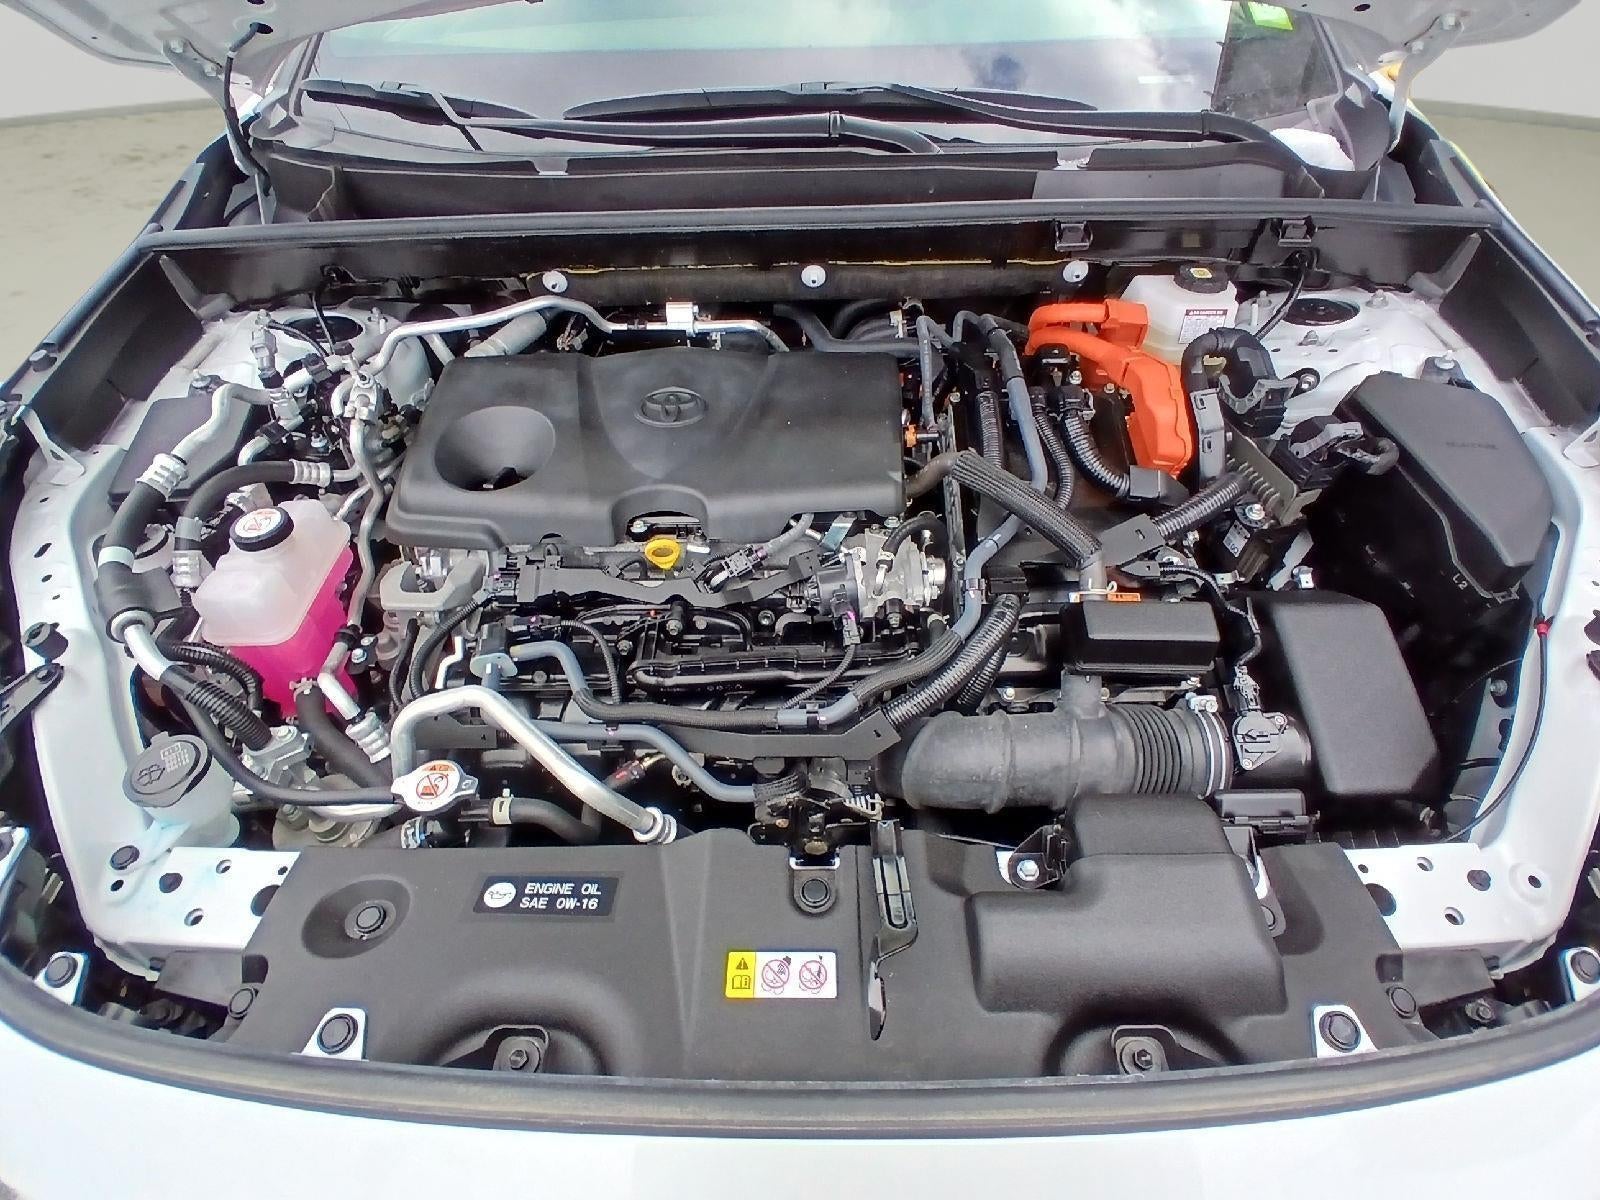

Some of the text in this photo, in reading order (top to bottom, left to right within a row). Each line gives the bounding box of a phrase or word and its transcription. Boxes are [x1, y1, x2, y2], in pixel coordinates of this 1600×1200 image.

[524, 882, 602, 895] ENGINE OIL
[519, 897, 599, 910] SAE 0W-16
